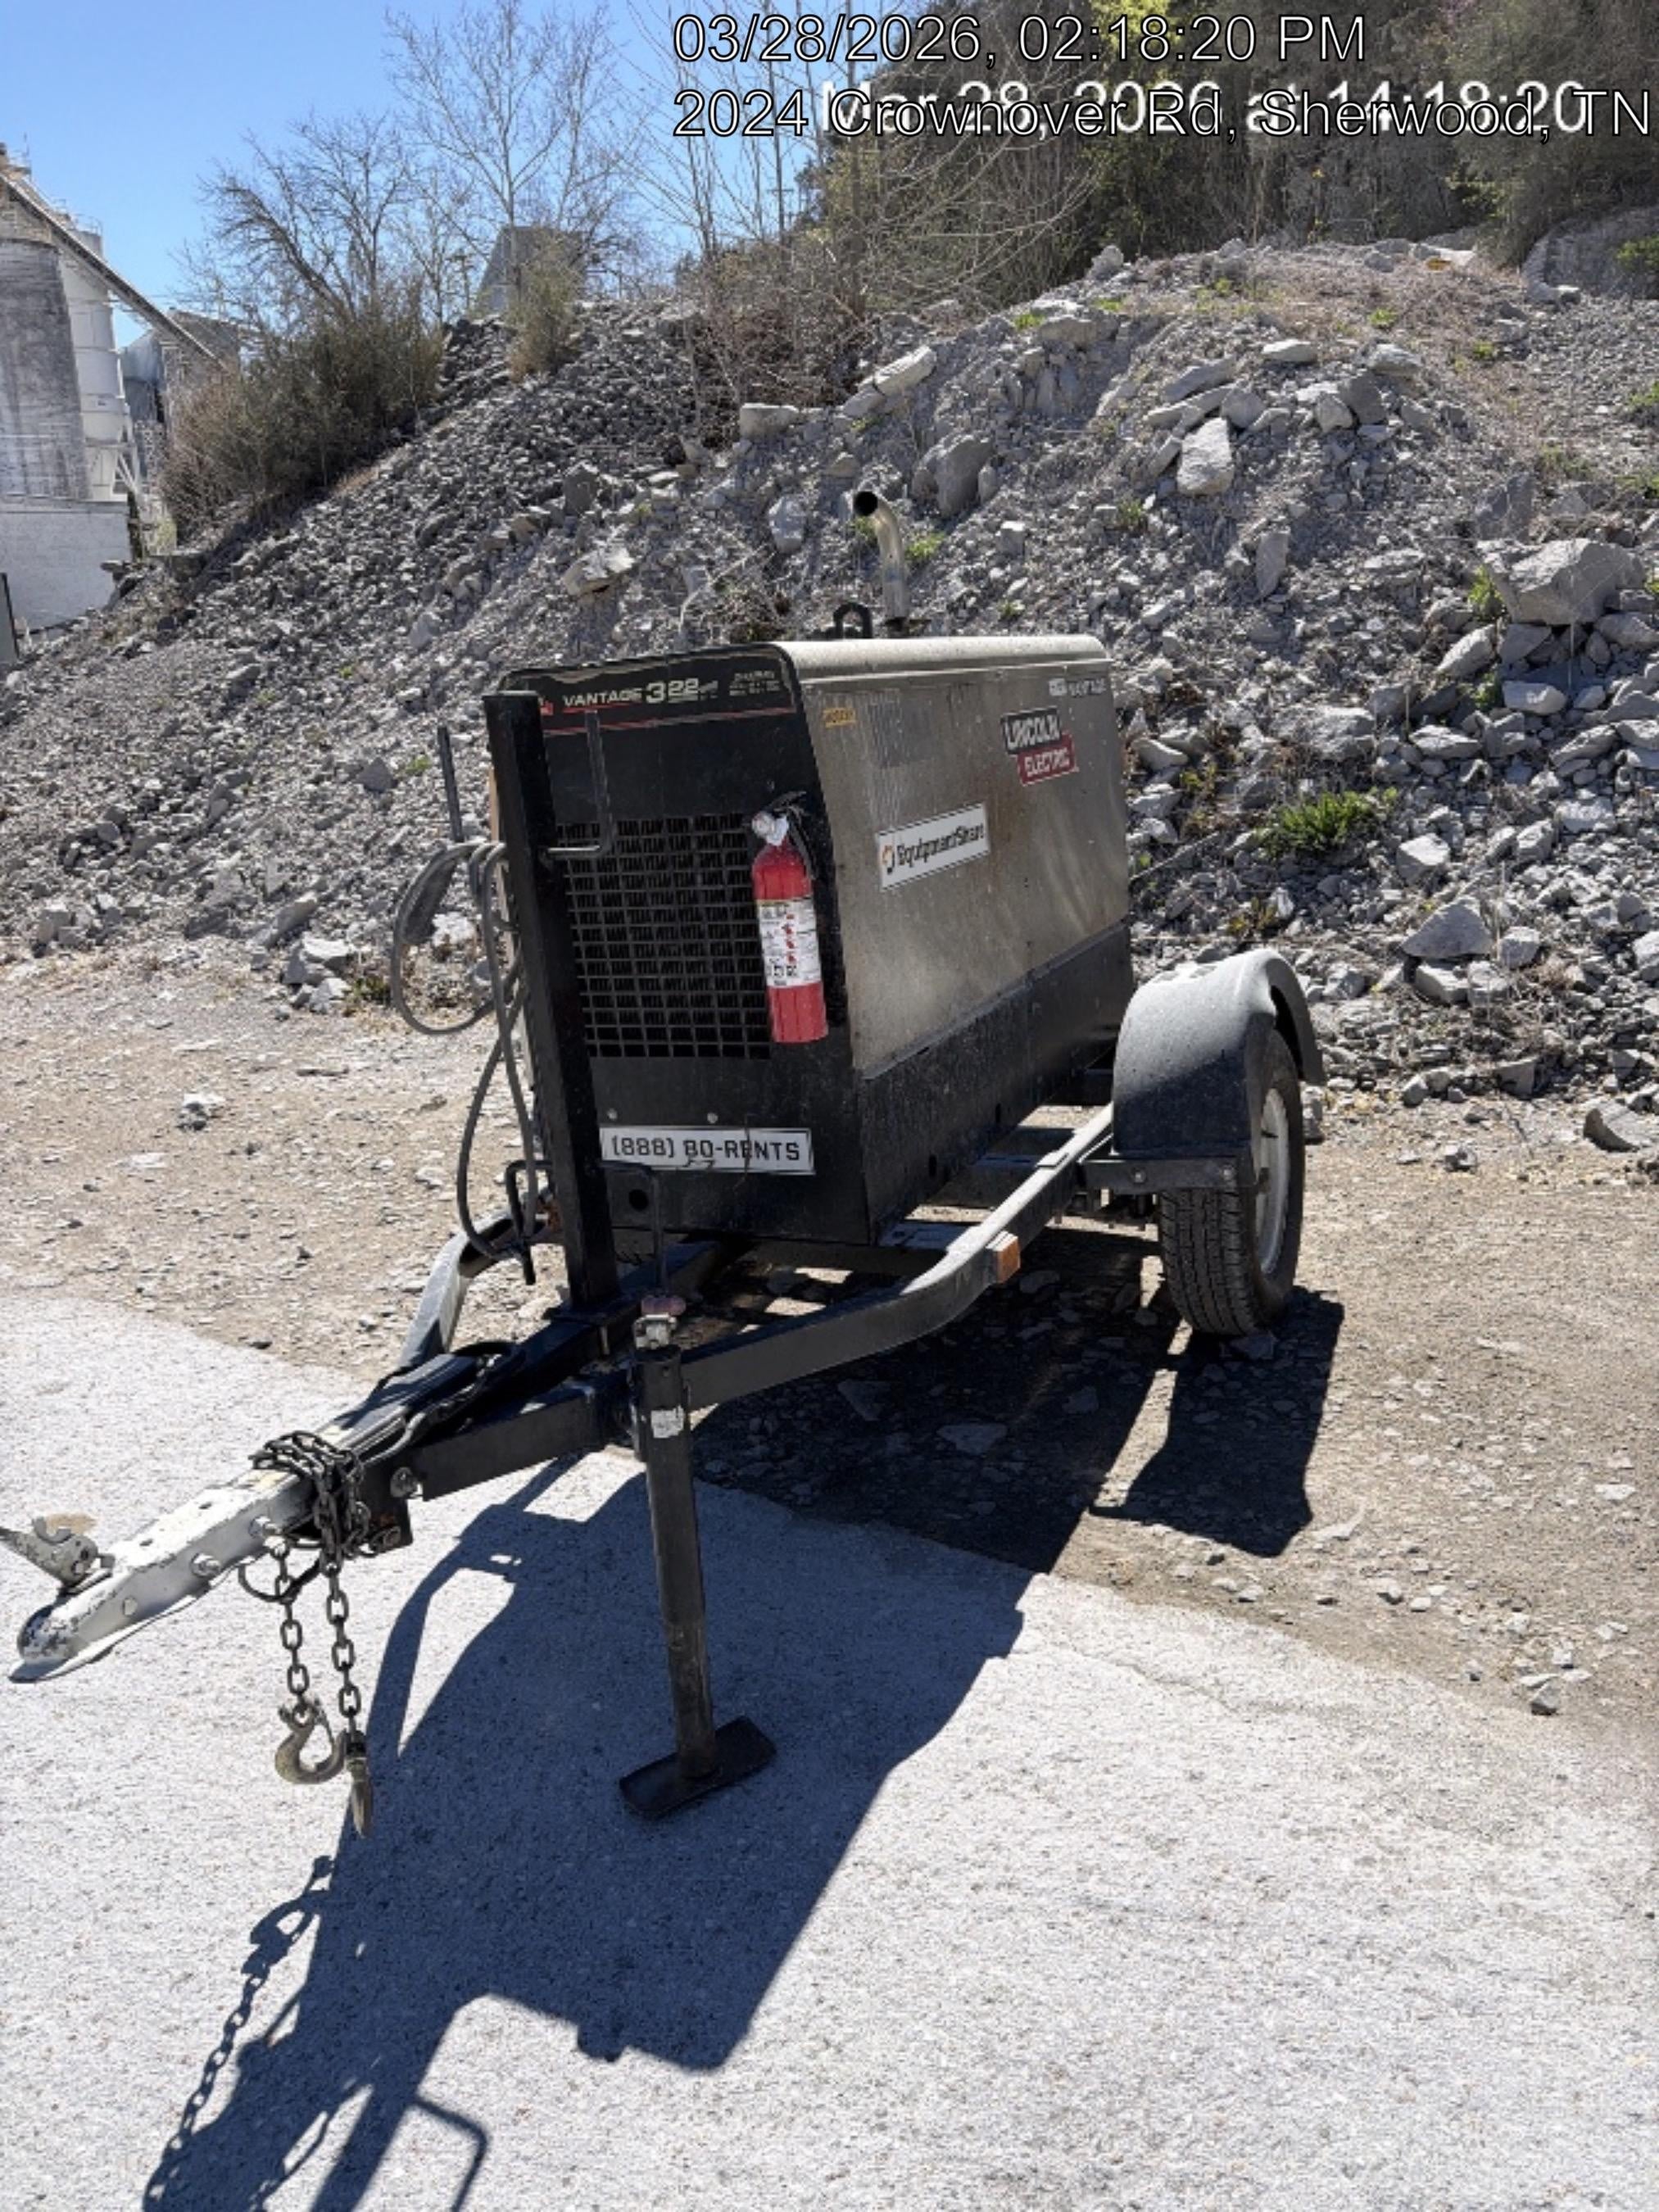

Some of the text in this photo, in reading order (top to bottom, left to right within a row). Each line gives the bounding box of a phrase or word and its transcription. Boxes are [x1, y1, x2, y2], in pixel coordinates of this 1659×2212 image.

[563, 686, 643, 707] VANTAGE
[645, 677, 700, 705] 322
[1004, 714, 1060, 750] LINCOLN
[1024, 747, 1071, 777] ELECTRIC
[612, 1135, 675, 1158] (888)
